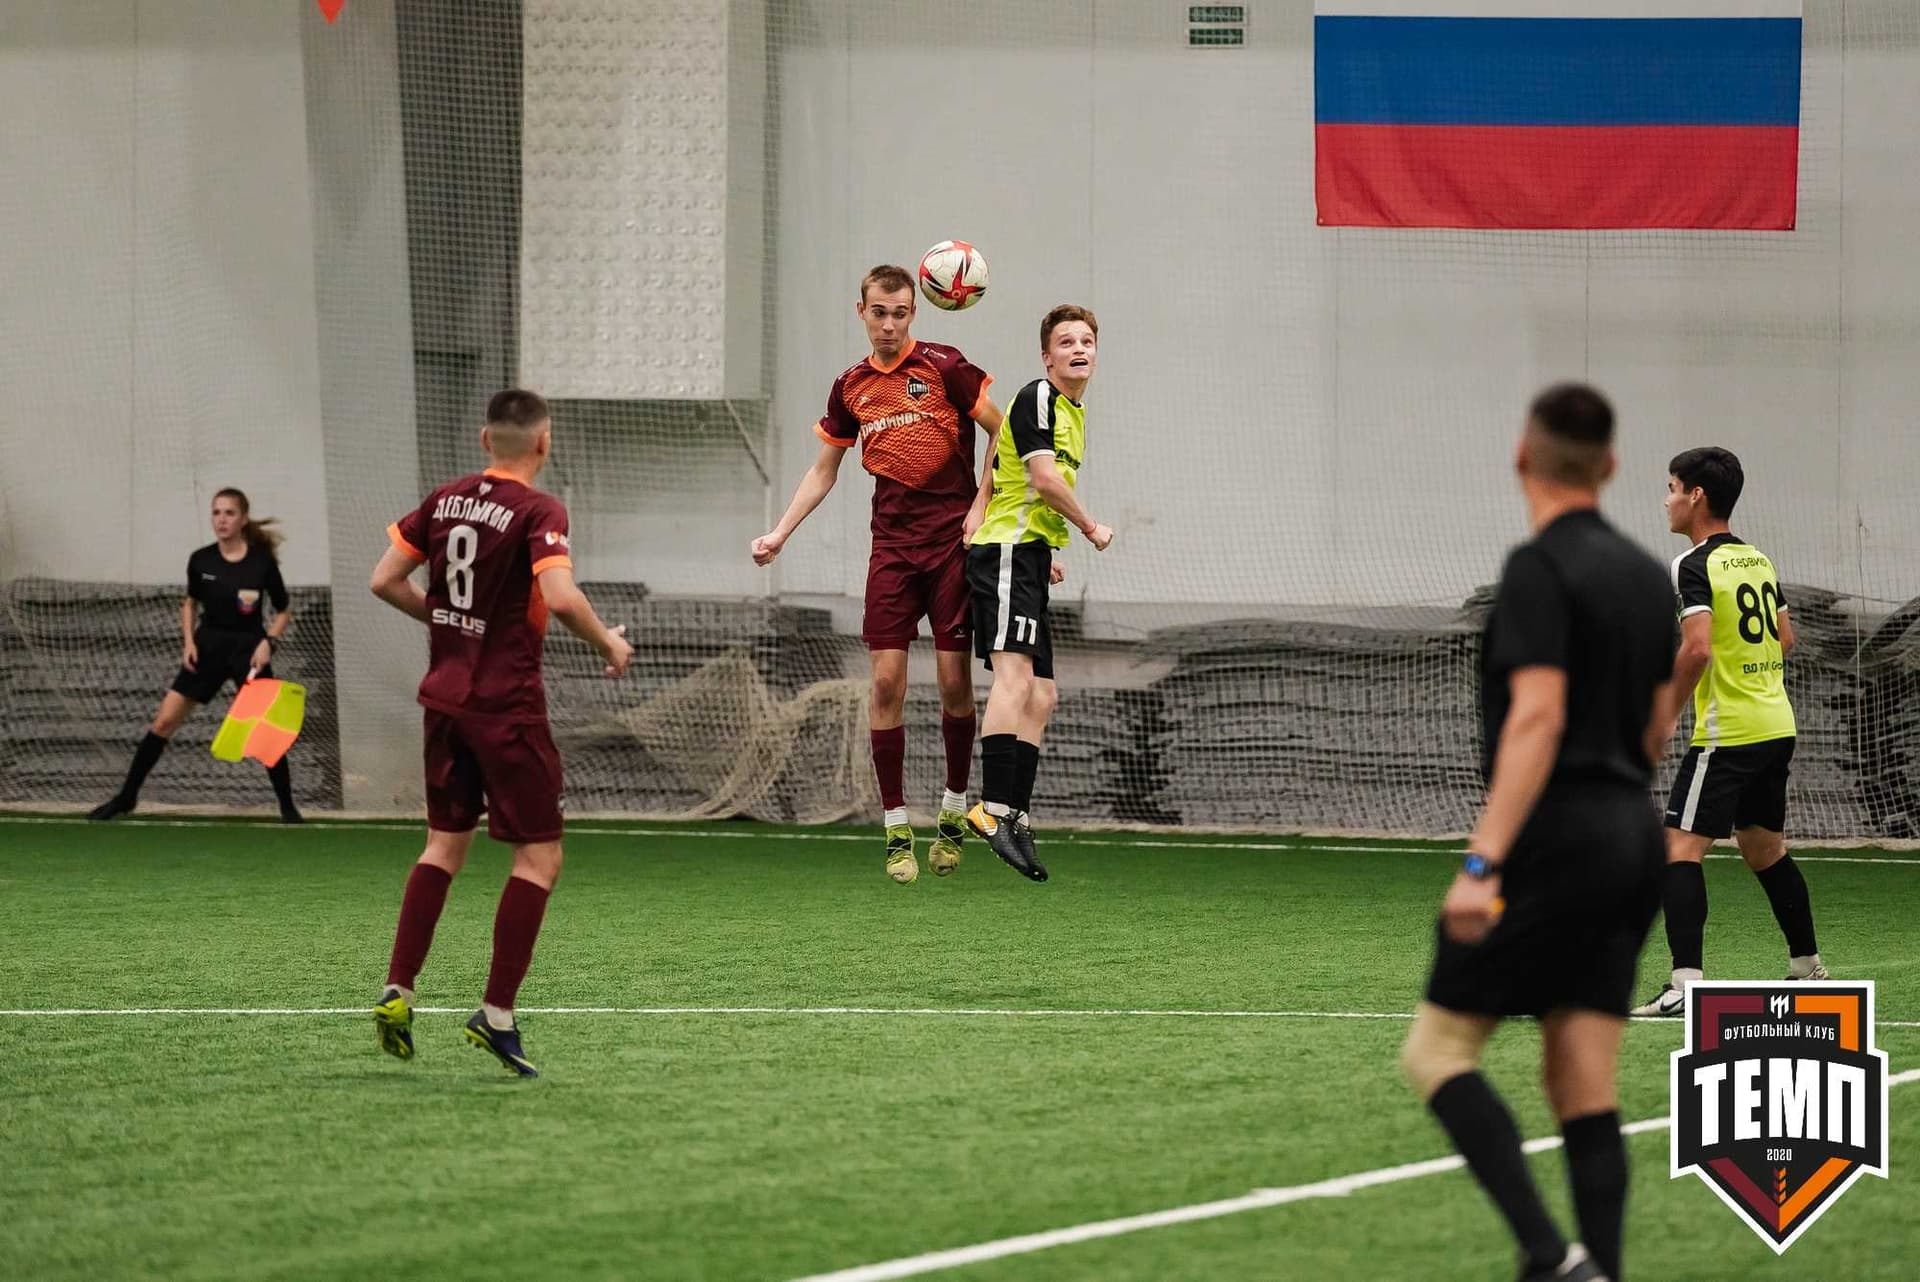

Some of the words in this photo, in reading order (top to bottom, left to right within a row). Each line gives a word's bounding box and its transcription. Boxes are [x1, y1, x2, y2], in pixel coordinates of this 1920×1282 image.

[446, 524, 478, 610] 8
[432, 608, 487, 635] SEUS
[1014, 615, 1037, 645] 11
[1736, 581, 1780, 644] 80
